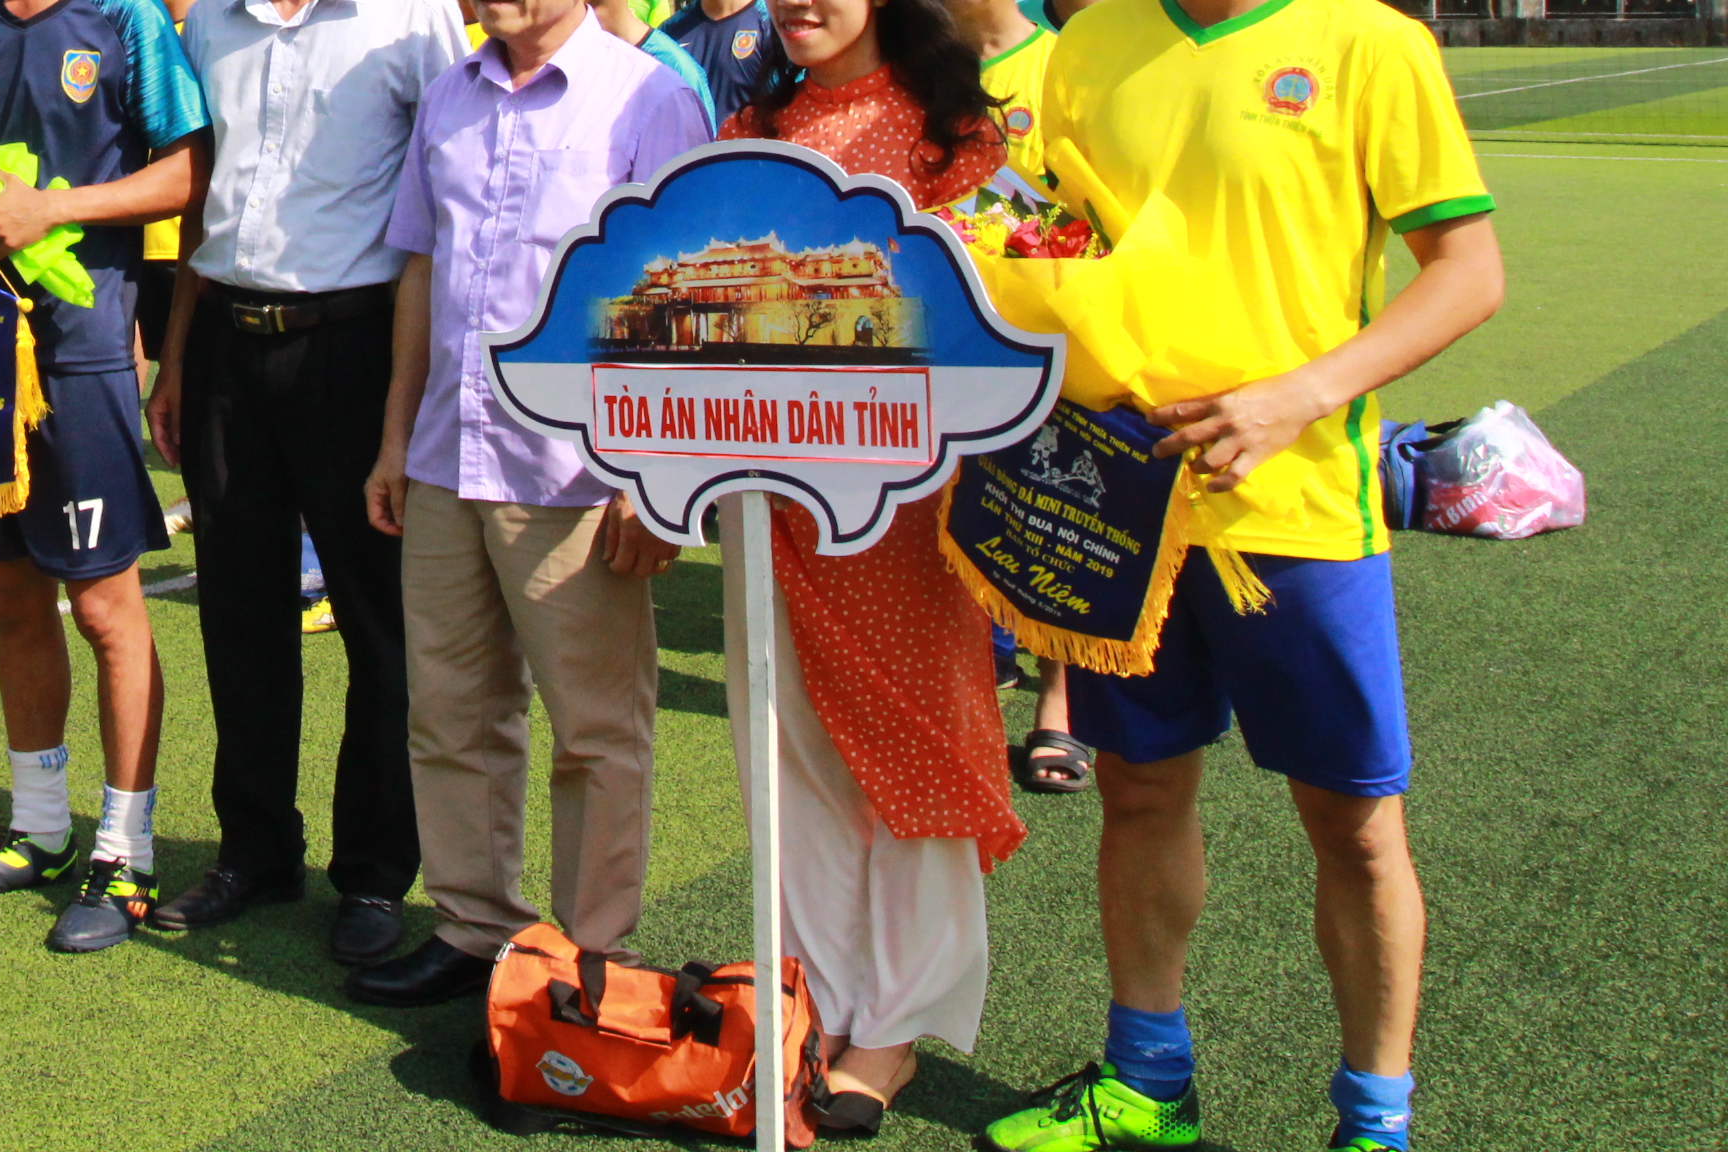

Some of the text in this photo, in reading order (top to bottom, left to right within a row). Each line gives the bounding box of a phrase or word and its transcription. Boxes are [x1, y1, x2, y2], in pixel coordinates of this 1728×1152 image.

[604, 385, 919, 448] TÒA ÁN NHÂN DÂN TỈNH
[1072, 411, 1089, 427] TỈNH
[1088, 422, 1108, 440] THỪA
[1109, 435, 1131, 454] THIÊN
[1131, 449, 1150, 464] HUẾ
[63, 498, 103, 550] 17
[985, 481, 1121, 564] KHỐI THI ĐUA NỘI CHÍNH
[1017, 486, 1034, 505] ĐÁ
[1034, 493, 1062, 515] MINI
[1105, 528, 1142, 556] THỐNG
[975, 536, 1091, 614] Lưu Niệm
[1005, 528, 1076, 574] BAN TỔ CHỨC
[1023, 529, 1044, 546] XIII
[1055, 543, 1084, 563] NĂM
[1086, 558, 1115, 578] 2019
